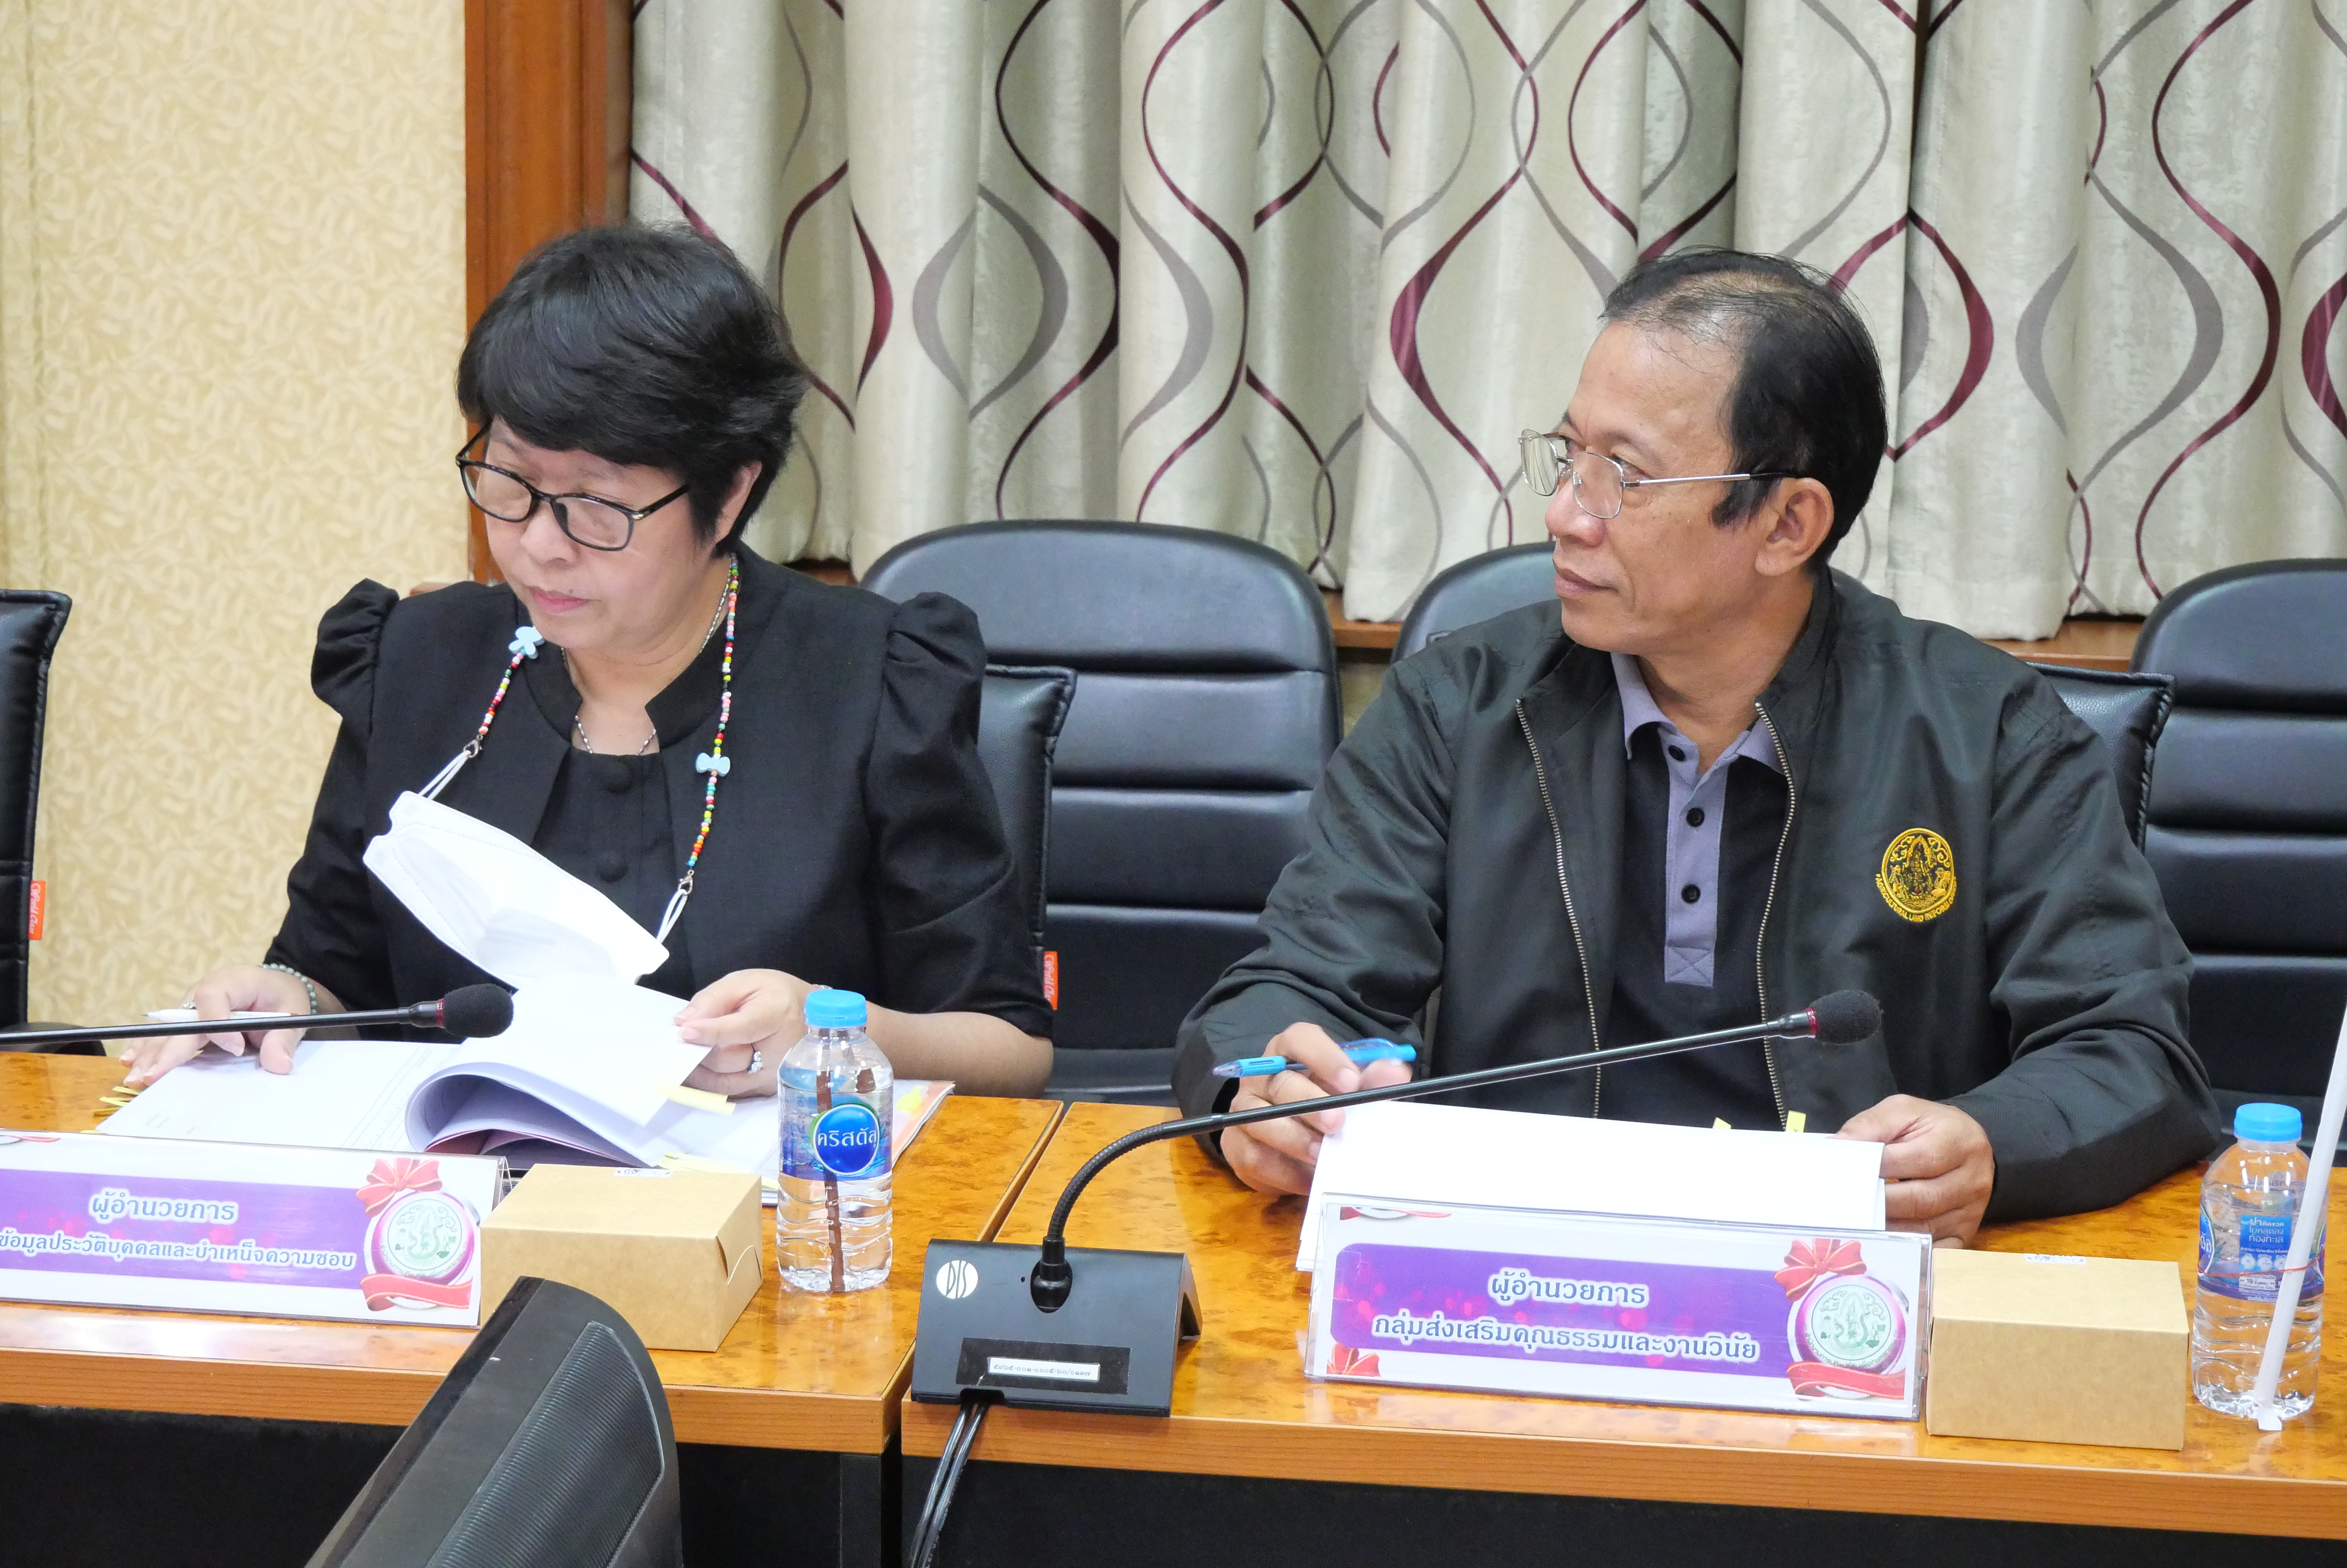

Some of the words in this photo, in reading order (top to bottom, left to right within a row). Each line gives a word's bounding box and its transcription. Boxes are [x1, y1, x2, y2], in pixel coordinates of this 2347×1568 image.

[1909, 914, 1924, 922] LAND
[818, 1127, 877, 1148] คริสตัล
[92, 1191, 235, 1220] ผู้อำนวยการ
[1492, 1271, 1645, 1304] ผู้อำนวยการ
[1375, 1312, 1756, 1359] กลุ่มส่งเสริมคุณธรรมและงานวินัย
